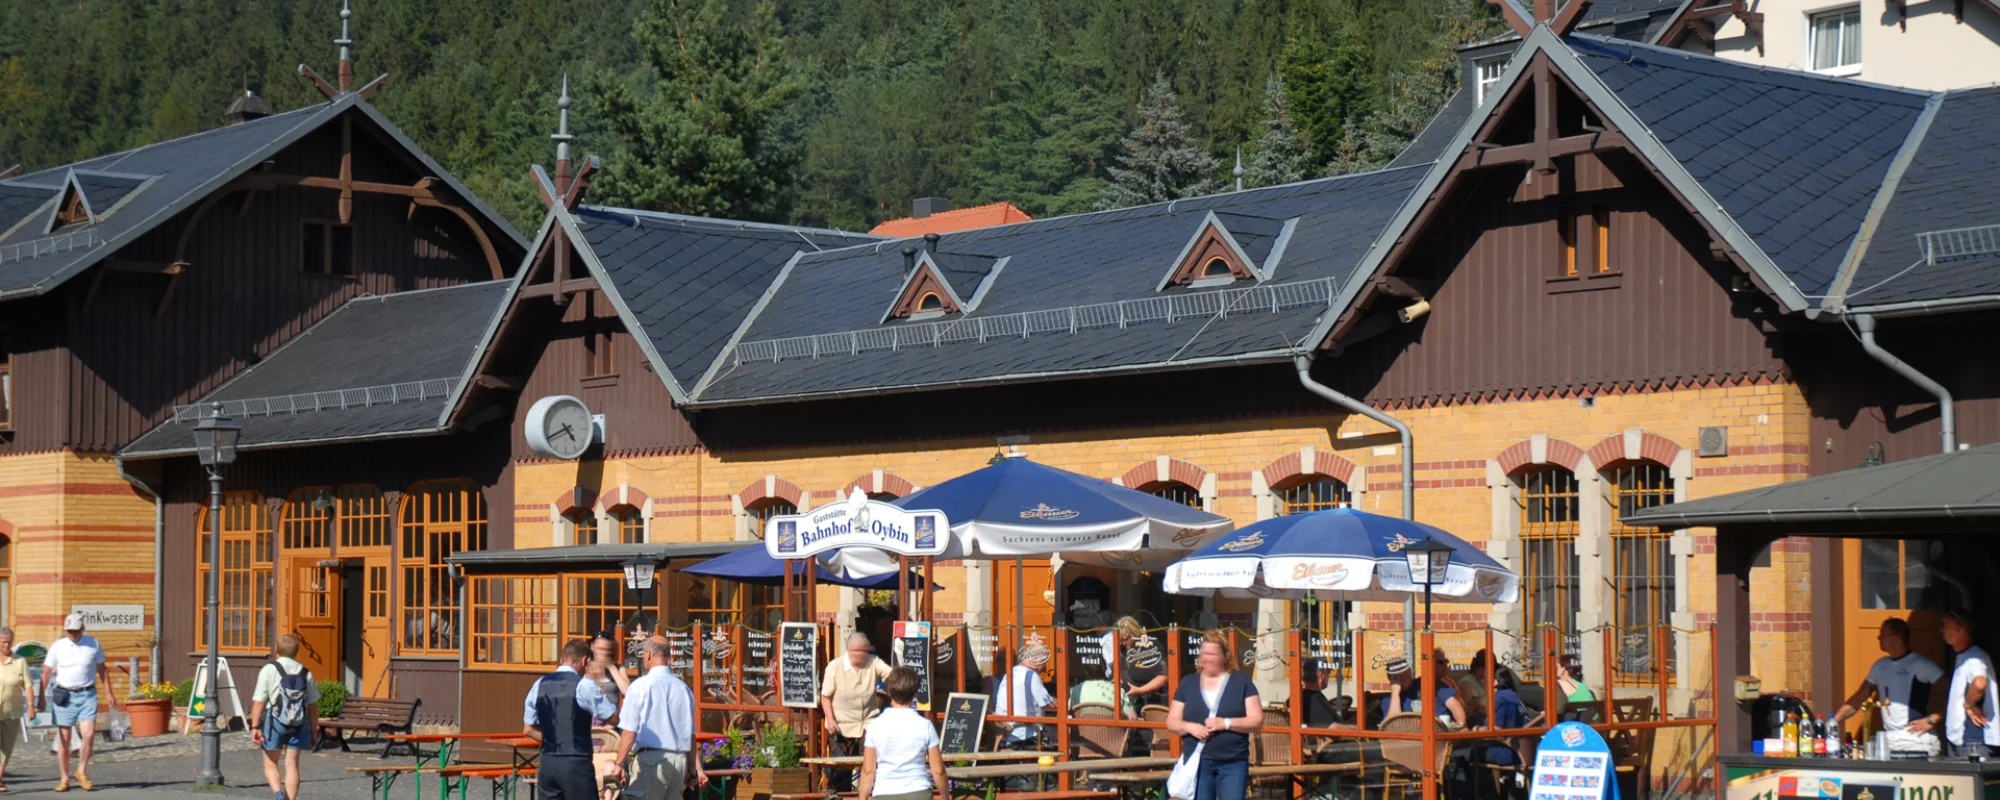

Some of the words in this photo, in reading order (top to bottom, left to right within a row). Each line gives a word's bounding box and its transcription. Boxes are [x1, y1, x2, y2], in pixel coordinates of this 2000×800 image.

[813, 509, 847, 524] Gaststätte
[801, 517, 854, 547] Bahnhof
[871, 519, 909, 544] Oybin
[1002, 535, 1045, 543] Sachsens
[1050, 534, 1092, 542] schwarze
[1311, 637, 1346, 646] Sachsens
[1311, 648, 1346, 657] schwarze
[1317, 661, 1340, 669] Kunst
